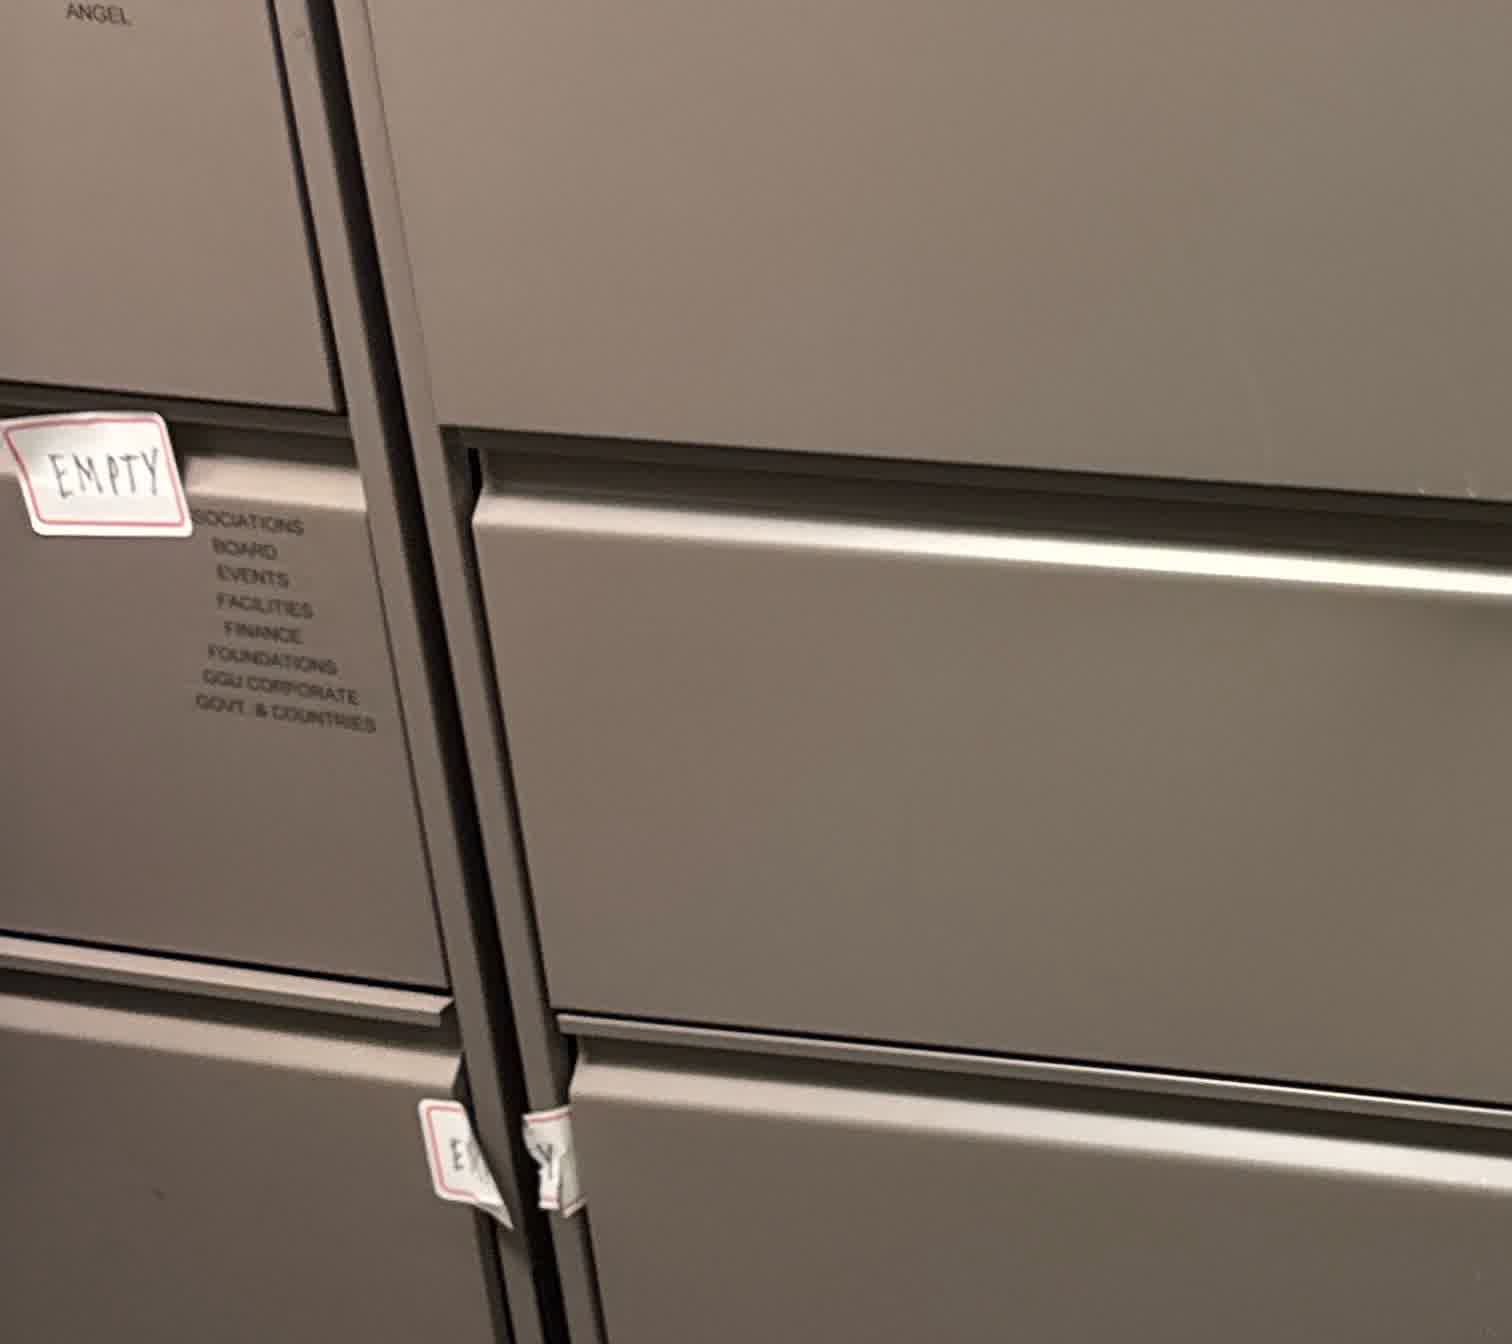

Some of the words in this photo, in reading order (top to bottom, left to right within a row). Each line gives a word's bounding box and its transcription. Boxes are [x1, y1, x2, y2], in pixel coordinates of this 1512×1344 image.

[66, 3, 131, 26] ANGEL
[48, 447, 160, 499] EMPTY
[191, 510, 304, 536] SOCIATIONS
[211, 536, 278, 560] BOARD
[216, 564, 289, 589] EVENTS
[216, 592, 314, 619] FACILITIES
[224, 621, 304, 644] FINANCE
[208, 644, 338, 676] FOUNDATIONS
[247, 676, 360, 706] CORPORATE
[271, 704, 377, 734] COUNTRIES
